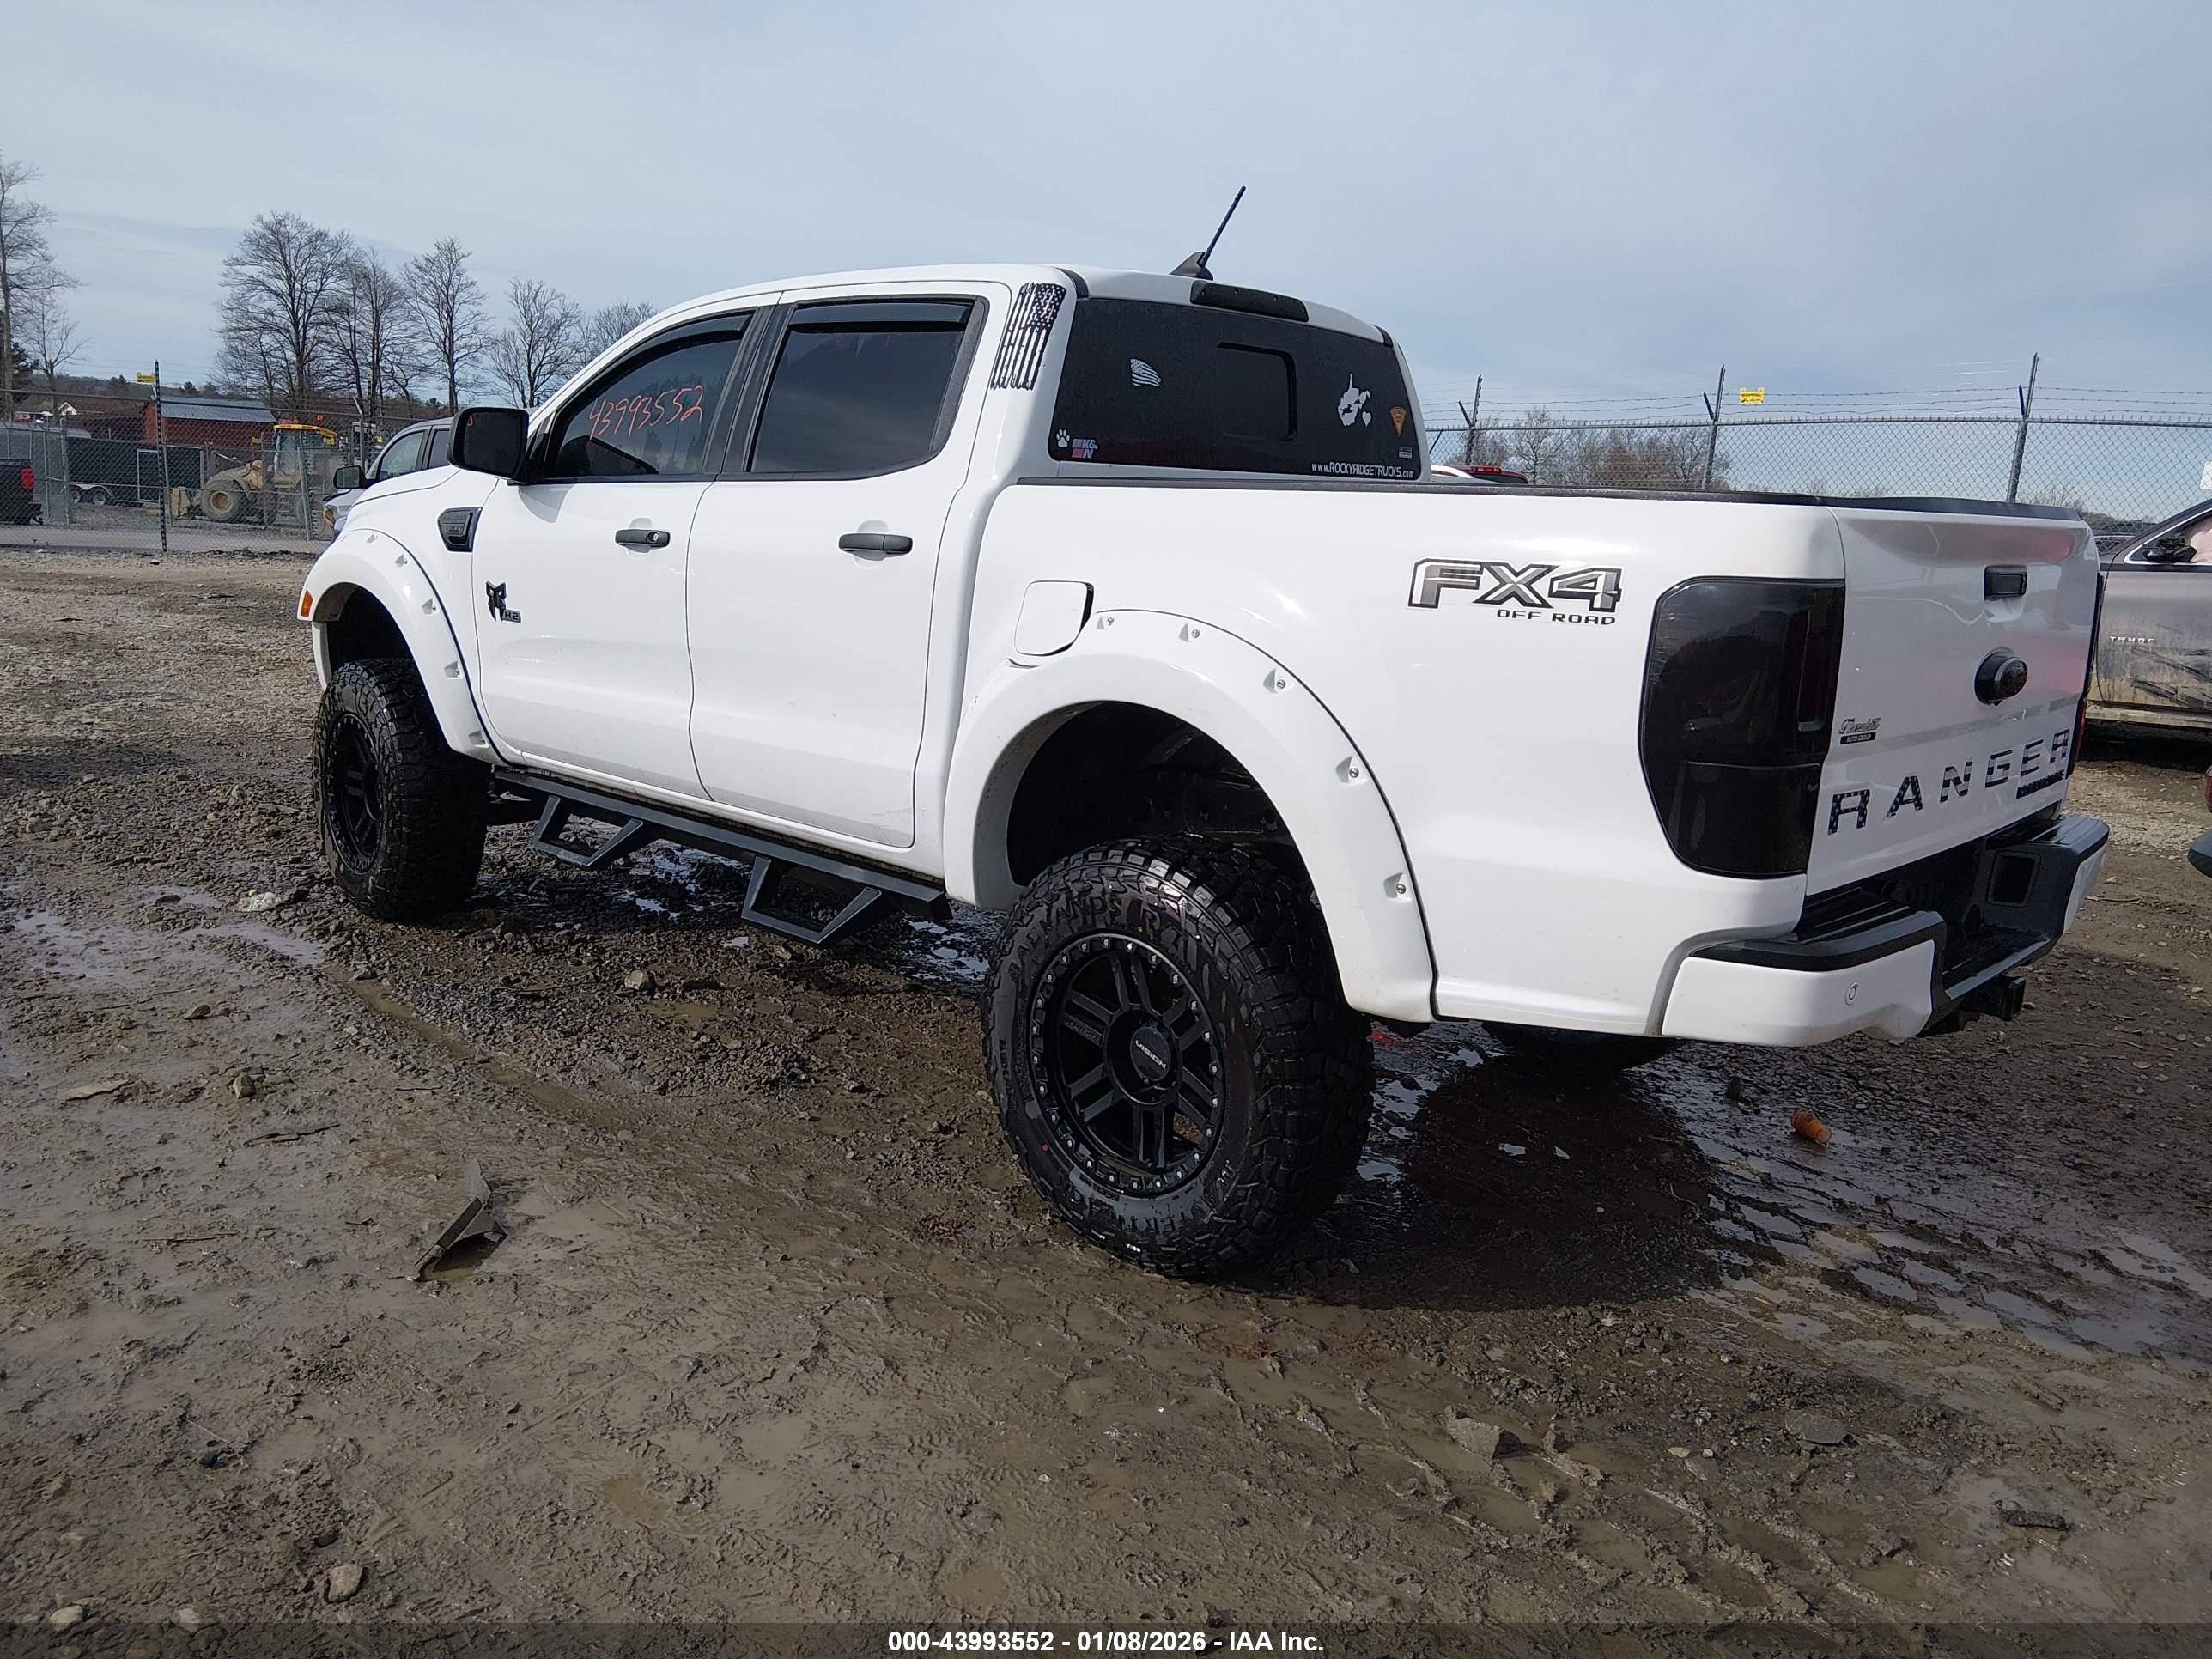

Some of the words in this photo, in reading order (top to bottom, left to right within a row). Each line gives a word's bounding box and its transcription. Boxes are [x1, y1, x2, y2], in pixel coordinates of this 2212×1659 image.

[589, 385, 704, 441] 43993552
[1407, 557, 1623, 613] FX4
[1497, 609, 1542, 620] OFF
[1552, 612, 1616, 625] ROAD
[1827, 728, 2069, 836] RANGER
[1135, 1040, 1167, 1070] VISION
